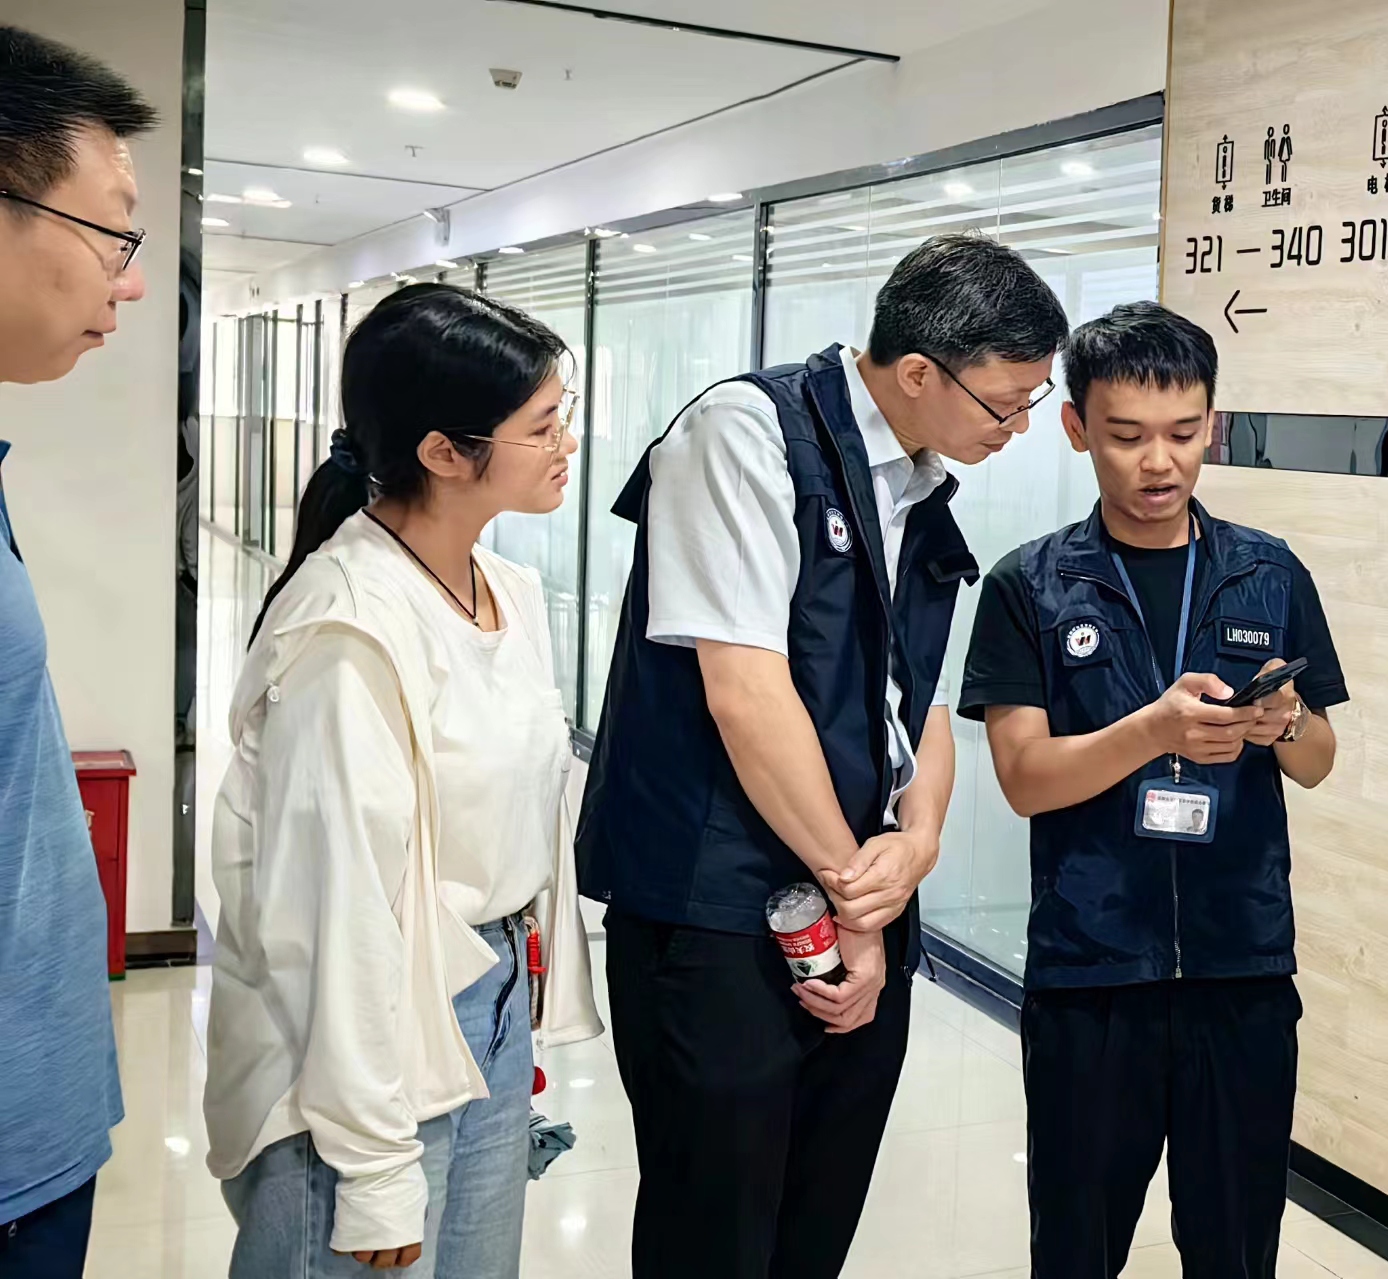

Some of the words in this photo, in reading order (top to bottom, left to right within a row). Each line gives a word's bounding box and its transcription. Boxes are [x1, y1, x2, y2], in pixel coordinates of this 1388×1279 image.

[1261, 187, 1292, 208] 卫生间
[1185, 234, 1223, 275] 321
[1270, 224, 1323, 269] 340
[1340, 217, 1388, 263] 301
[1226, 627, 1270, 646] LH030079
